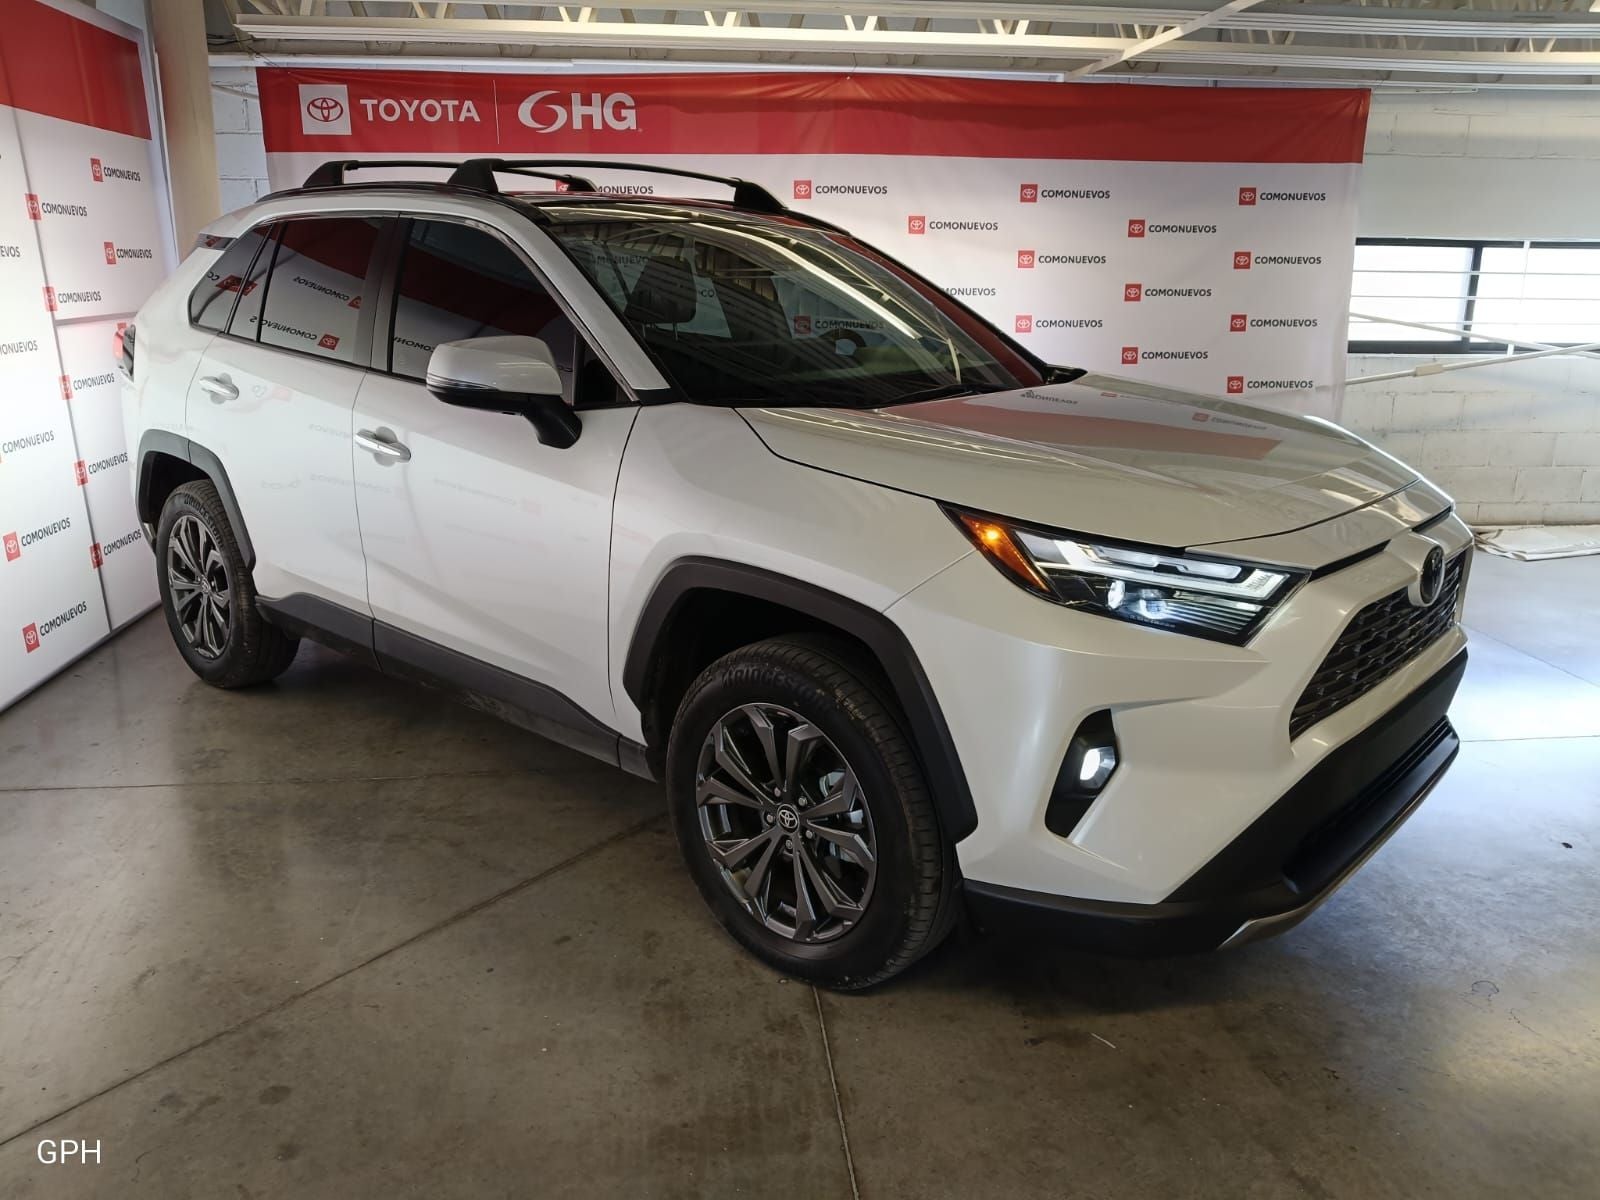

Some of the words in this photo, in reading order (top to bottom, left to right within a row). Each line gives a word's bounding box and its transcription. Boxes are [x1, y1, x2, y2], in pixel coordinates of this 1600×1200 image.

[360, 99, 481, 122] TOYOTA
[103, 167, 141, 181] COMONUEVOS
[815, 185, 888, 195] COMONUEVOS
[1040, 189, 1111, 199] COMONUEVOS
[1259, 192, 1326, 201] COMONUEVOS
[41, 202, 88, 217] COMONUEVOS
[928, 220, 999, 231] COMONUEVOS
[1148, 224, 1217, 234] COMONUEVOS
[0, 246, 20, 258] EVOS
[116, 249, 152, 259] COMONUEVOS
[1038, 255, 1107, 264] COMONUEVOS
[1254, 255, 1322, 265] COMONUEVOS
[58, 291, 102, 303] COMONUEVOS
[1144, 288, 1212, 297] COMONUEVOS
[1035, 319, 1103, 328] COMONUEVOS
[1249, 318, 1318, 328] COMONUEVOS
[1141, 351, 1209, 360] COMONUEVOS
[73, 373, 115, 391] COMONUEVOS
[1246, 380, 1314, 389] COMONUEVOS
[2, 430, 55, 454] COMONUEVOS
[88, 452, 128, 475] COMONUEVOS
[21, 517, 71, 547] COMONUEVOS
[103, 529, 142, 556] COMONUEVOS
[40, 601, 87, 637] COMONUEVOS
